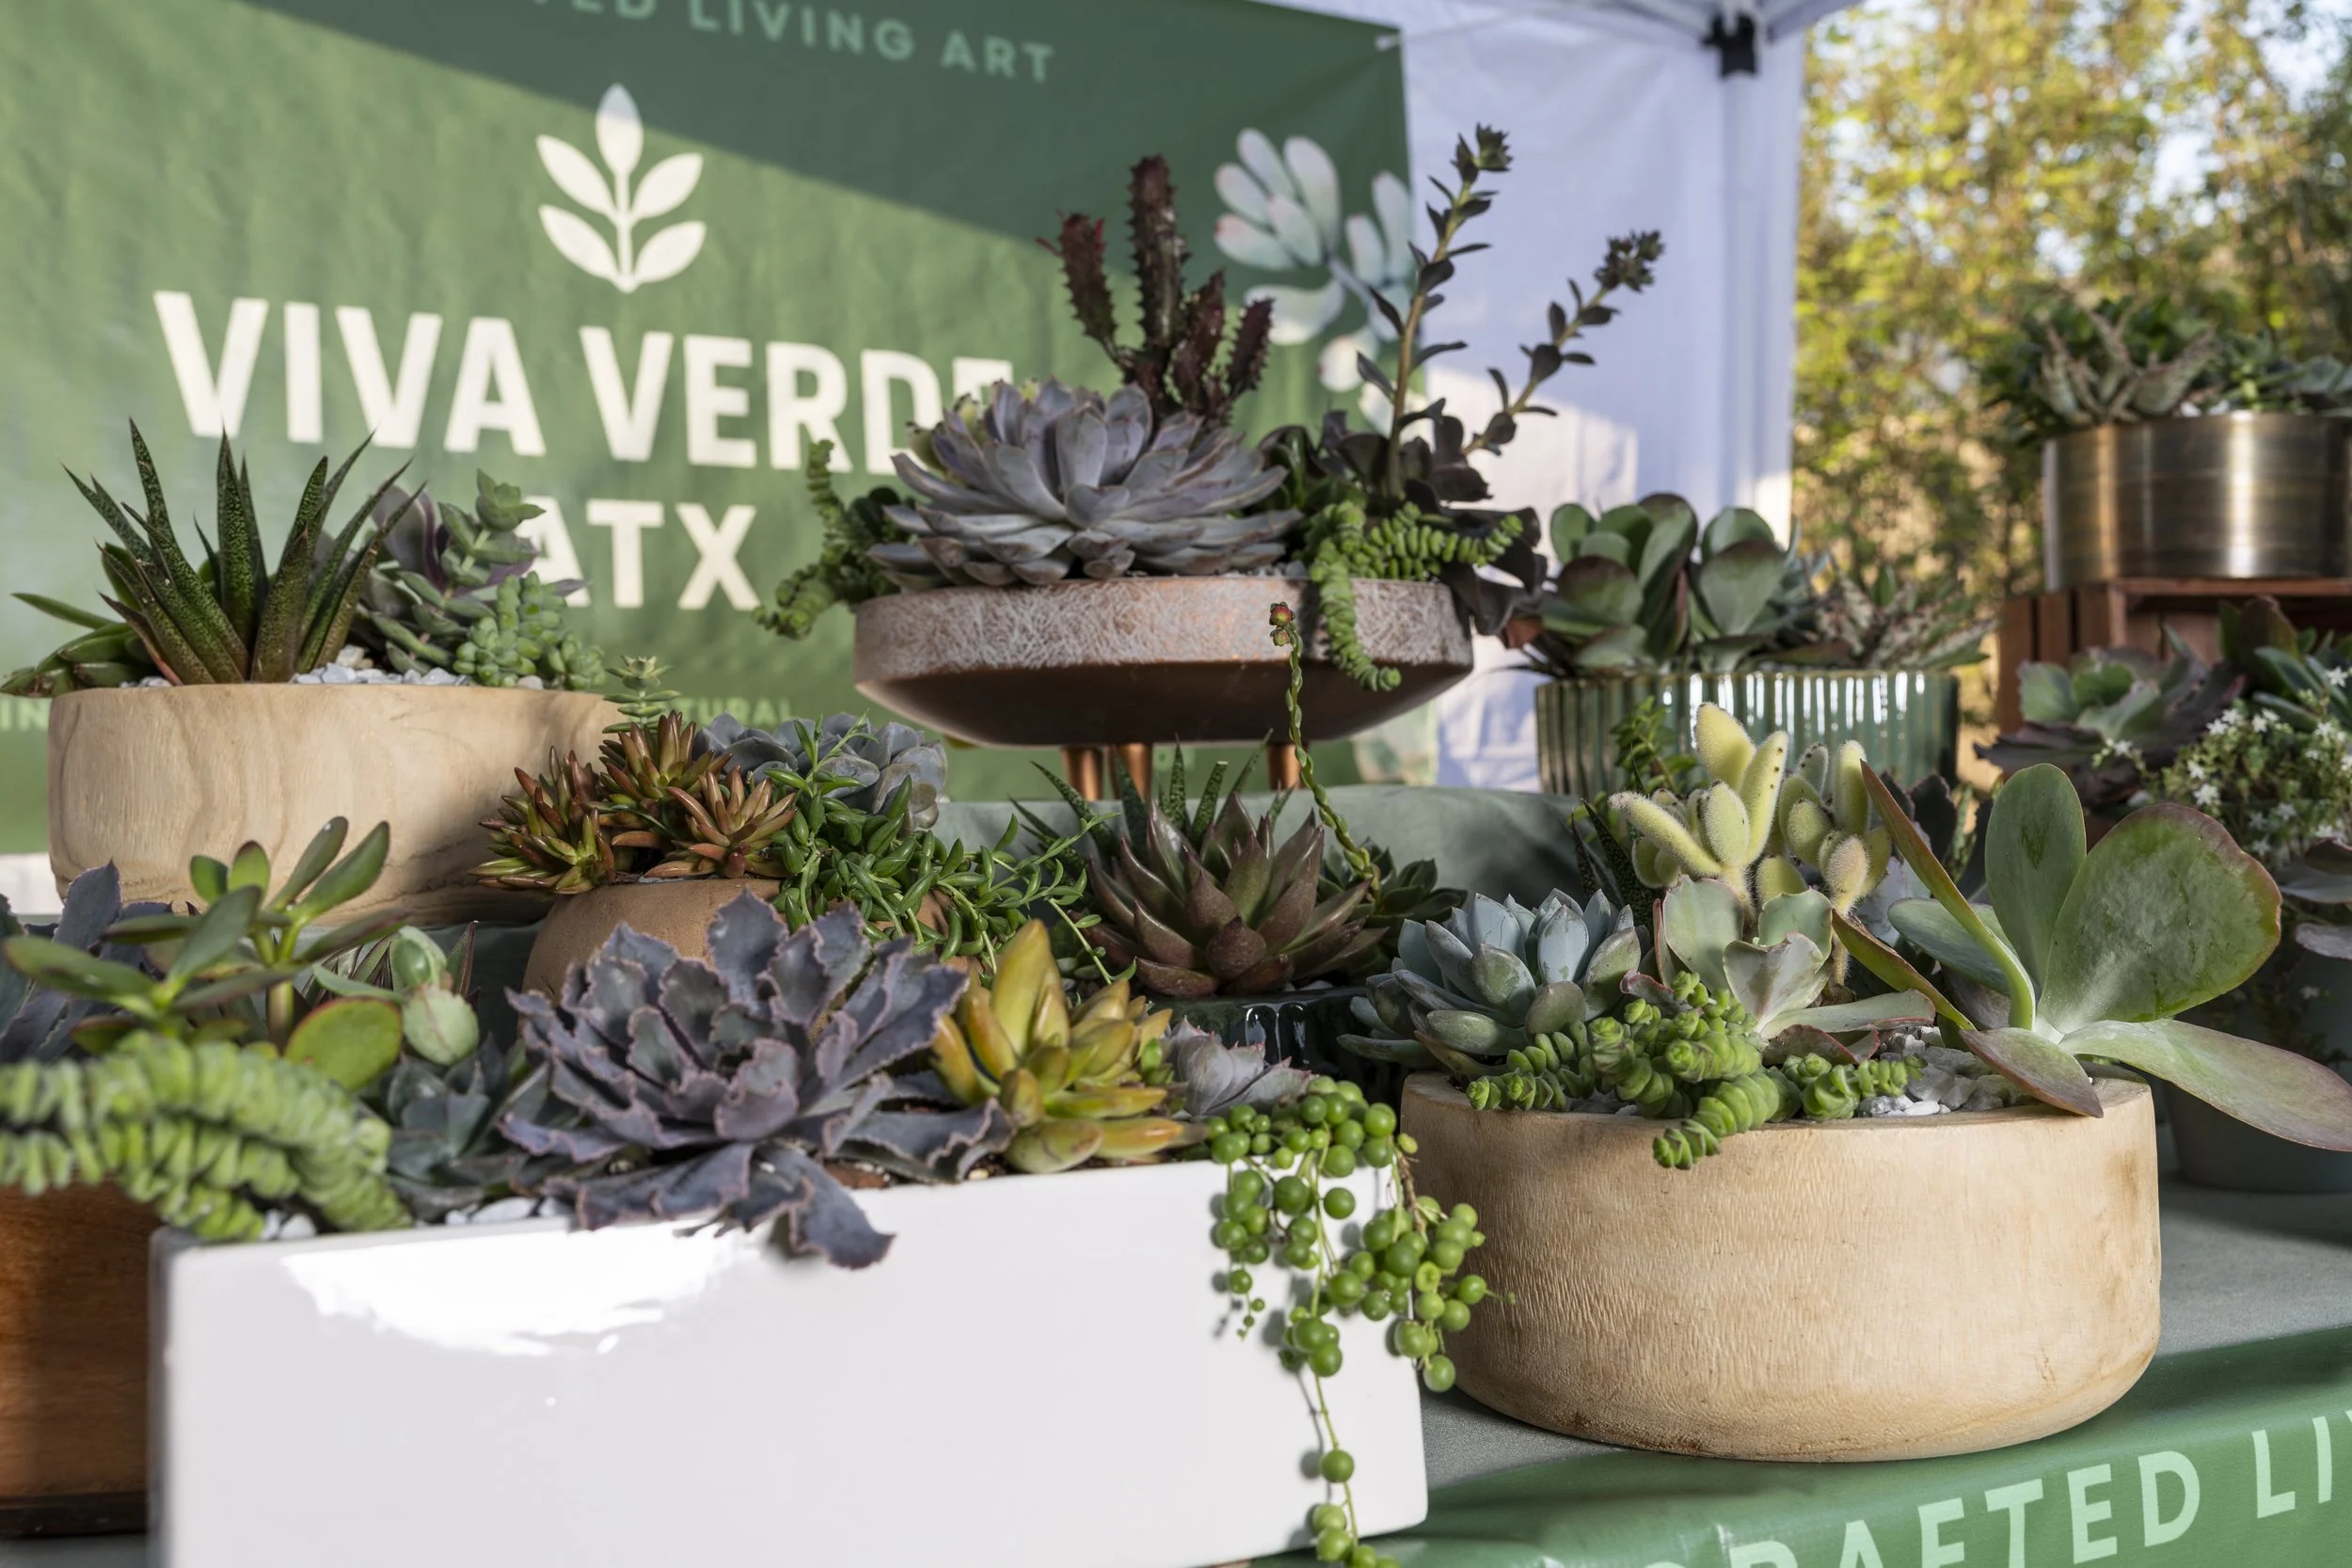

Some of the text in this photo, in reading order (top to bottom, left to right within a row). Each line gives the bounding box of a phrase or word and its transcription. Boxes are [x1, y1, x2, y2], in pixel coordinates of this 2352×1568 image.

[689, 0, 1056, 84] LIVING ART
[152, 289, 547, 458] VIVA
[515, 495, 761, 611] ATX
[2251, 1409, 2352, 1520] LI
